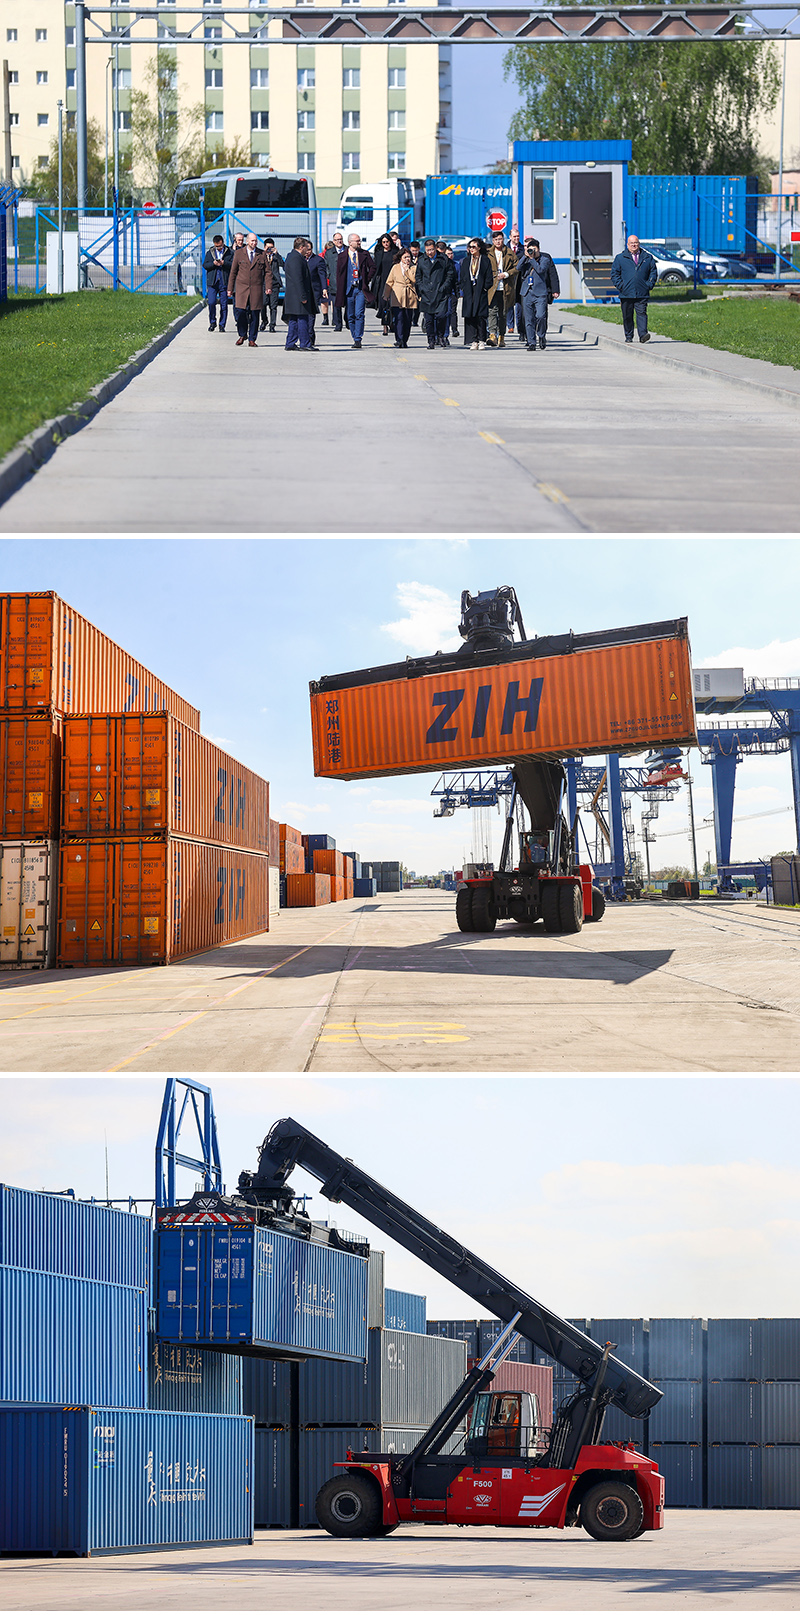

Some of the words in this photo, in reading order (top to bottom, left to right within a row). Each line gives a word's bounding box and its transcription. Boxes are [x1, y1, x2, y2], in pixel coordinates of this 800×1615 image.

[325, 700, 342, 764] 郑州陆港
[426, 677, 544, 744] ZIH
[215, 767, 246, 829] ZIH
[214, 867, 245, 924] ZIH
